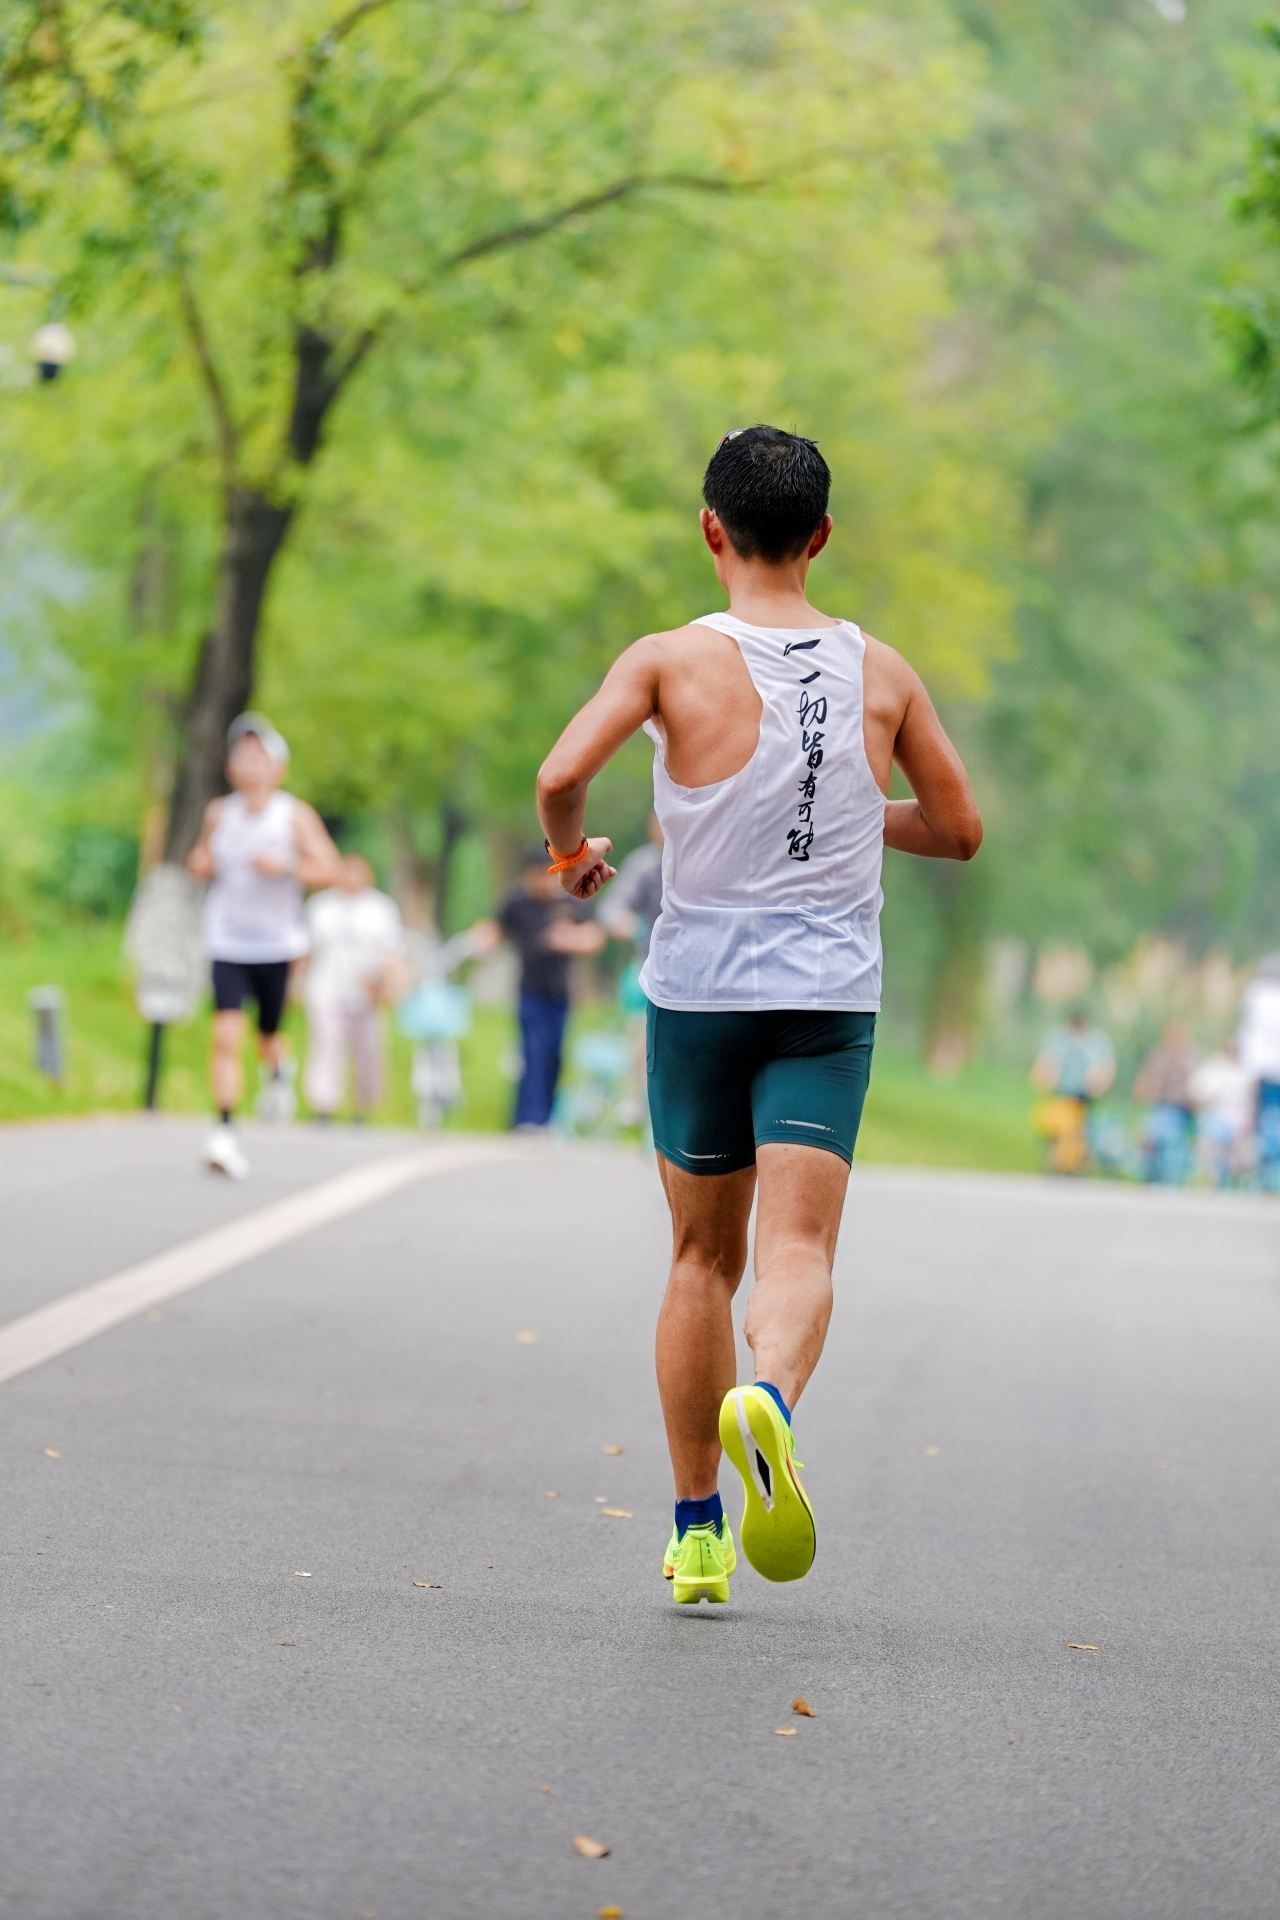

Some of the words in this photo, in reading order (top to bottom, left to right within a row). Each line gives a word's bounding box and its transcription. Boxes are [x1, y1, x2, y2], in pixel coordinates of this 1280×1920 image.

[786, 671, 828, 862] 一切皆有可能
